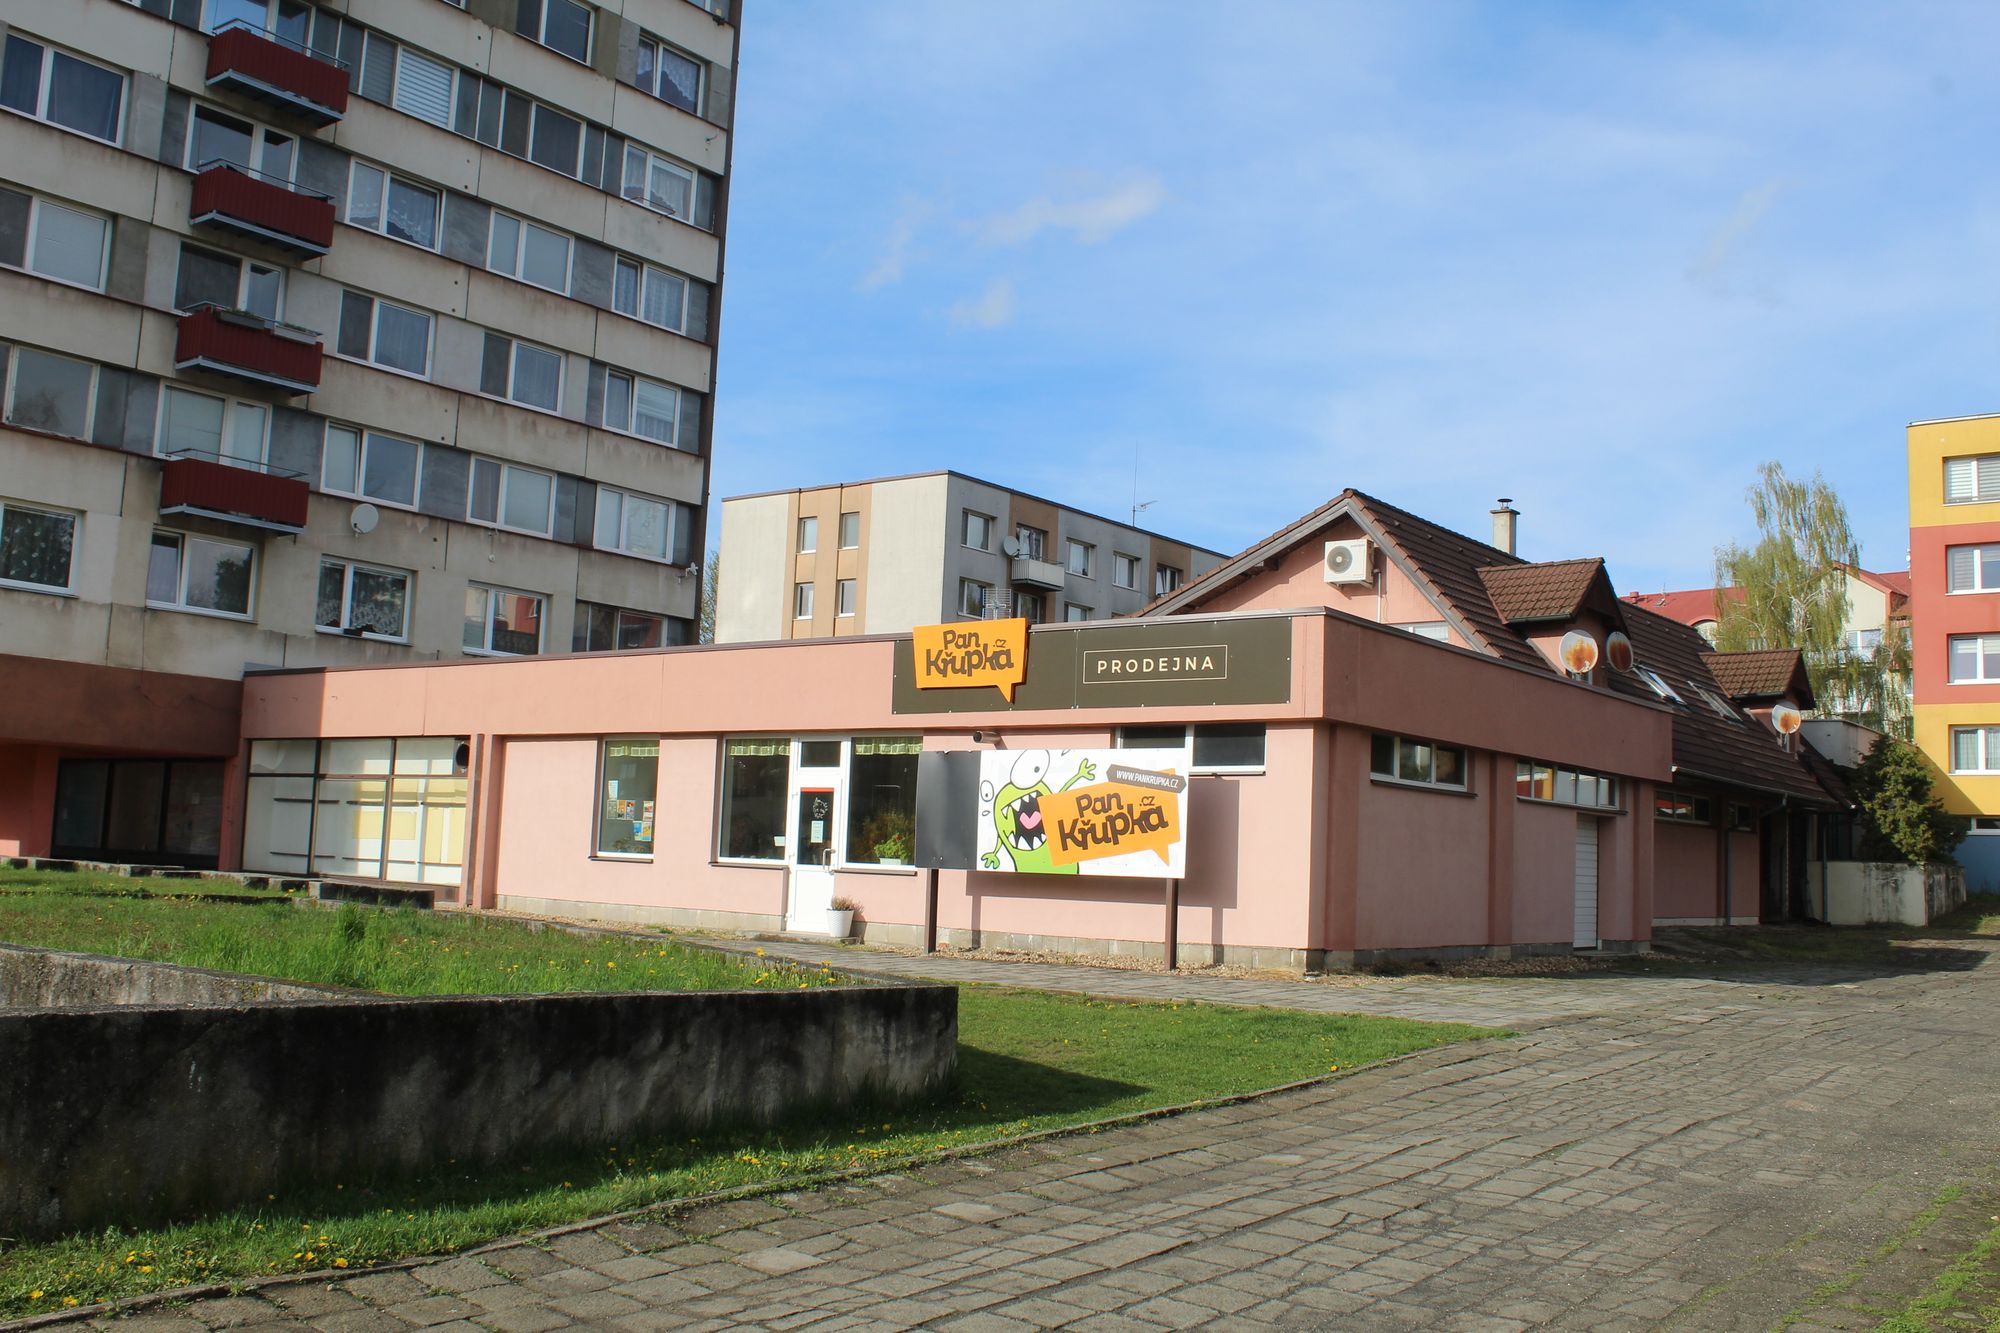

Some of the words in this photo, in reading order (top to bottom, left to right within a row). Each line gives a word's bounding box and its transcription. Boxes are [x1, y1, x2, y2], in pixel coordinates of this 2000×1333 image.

[943, 629, 980, 650] Pan
[926, 643, 1015, 677] Křupka
[1097, 656, 1214, 674] PRODEJNA
[1116, 769, 1179, 789] WWW.PANKRUPKA.CZ
[1075, 793, 1123, 818] Pan
[1058, 803, 1169, 851] Křupka
